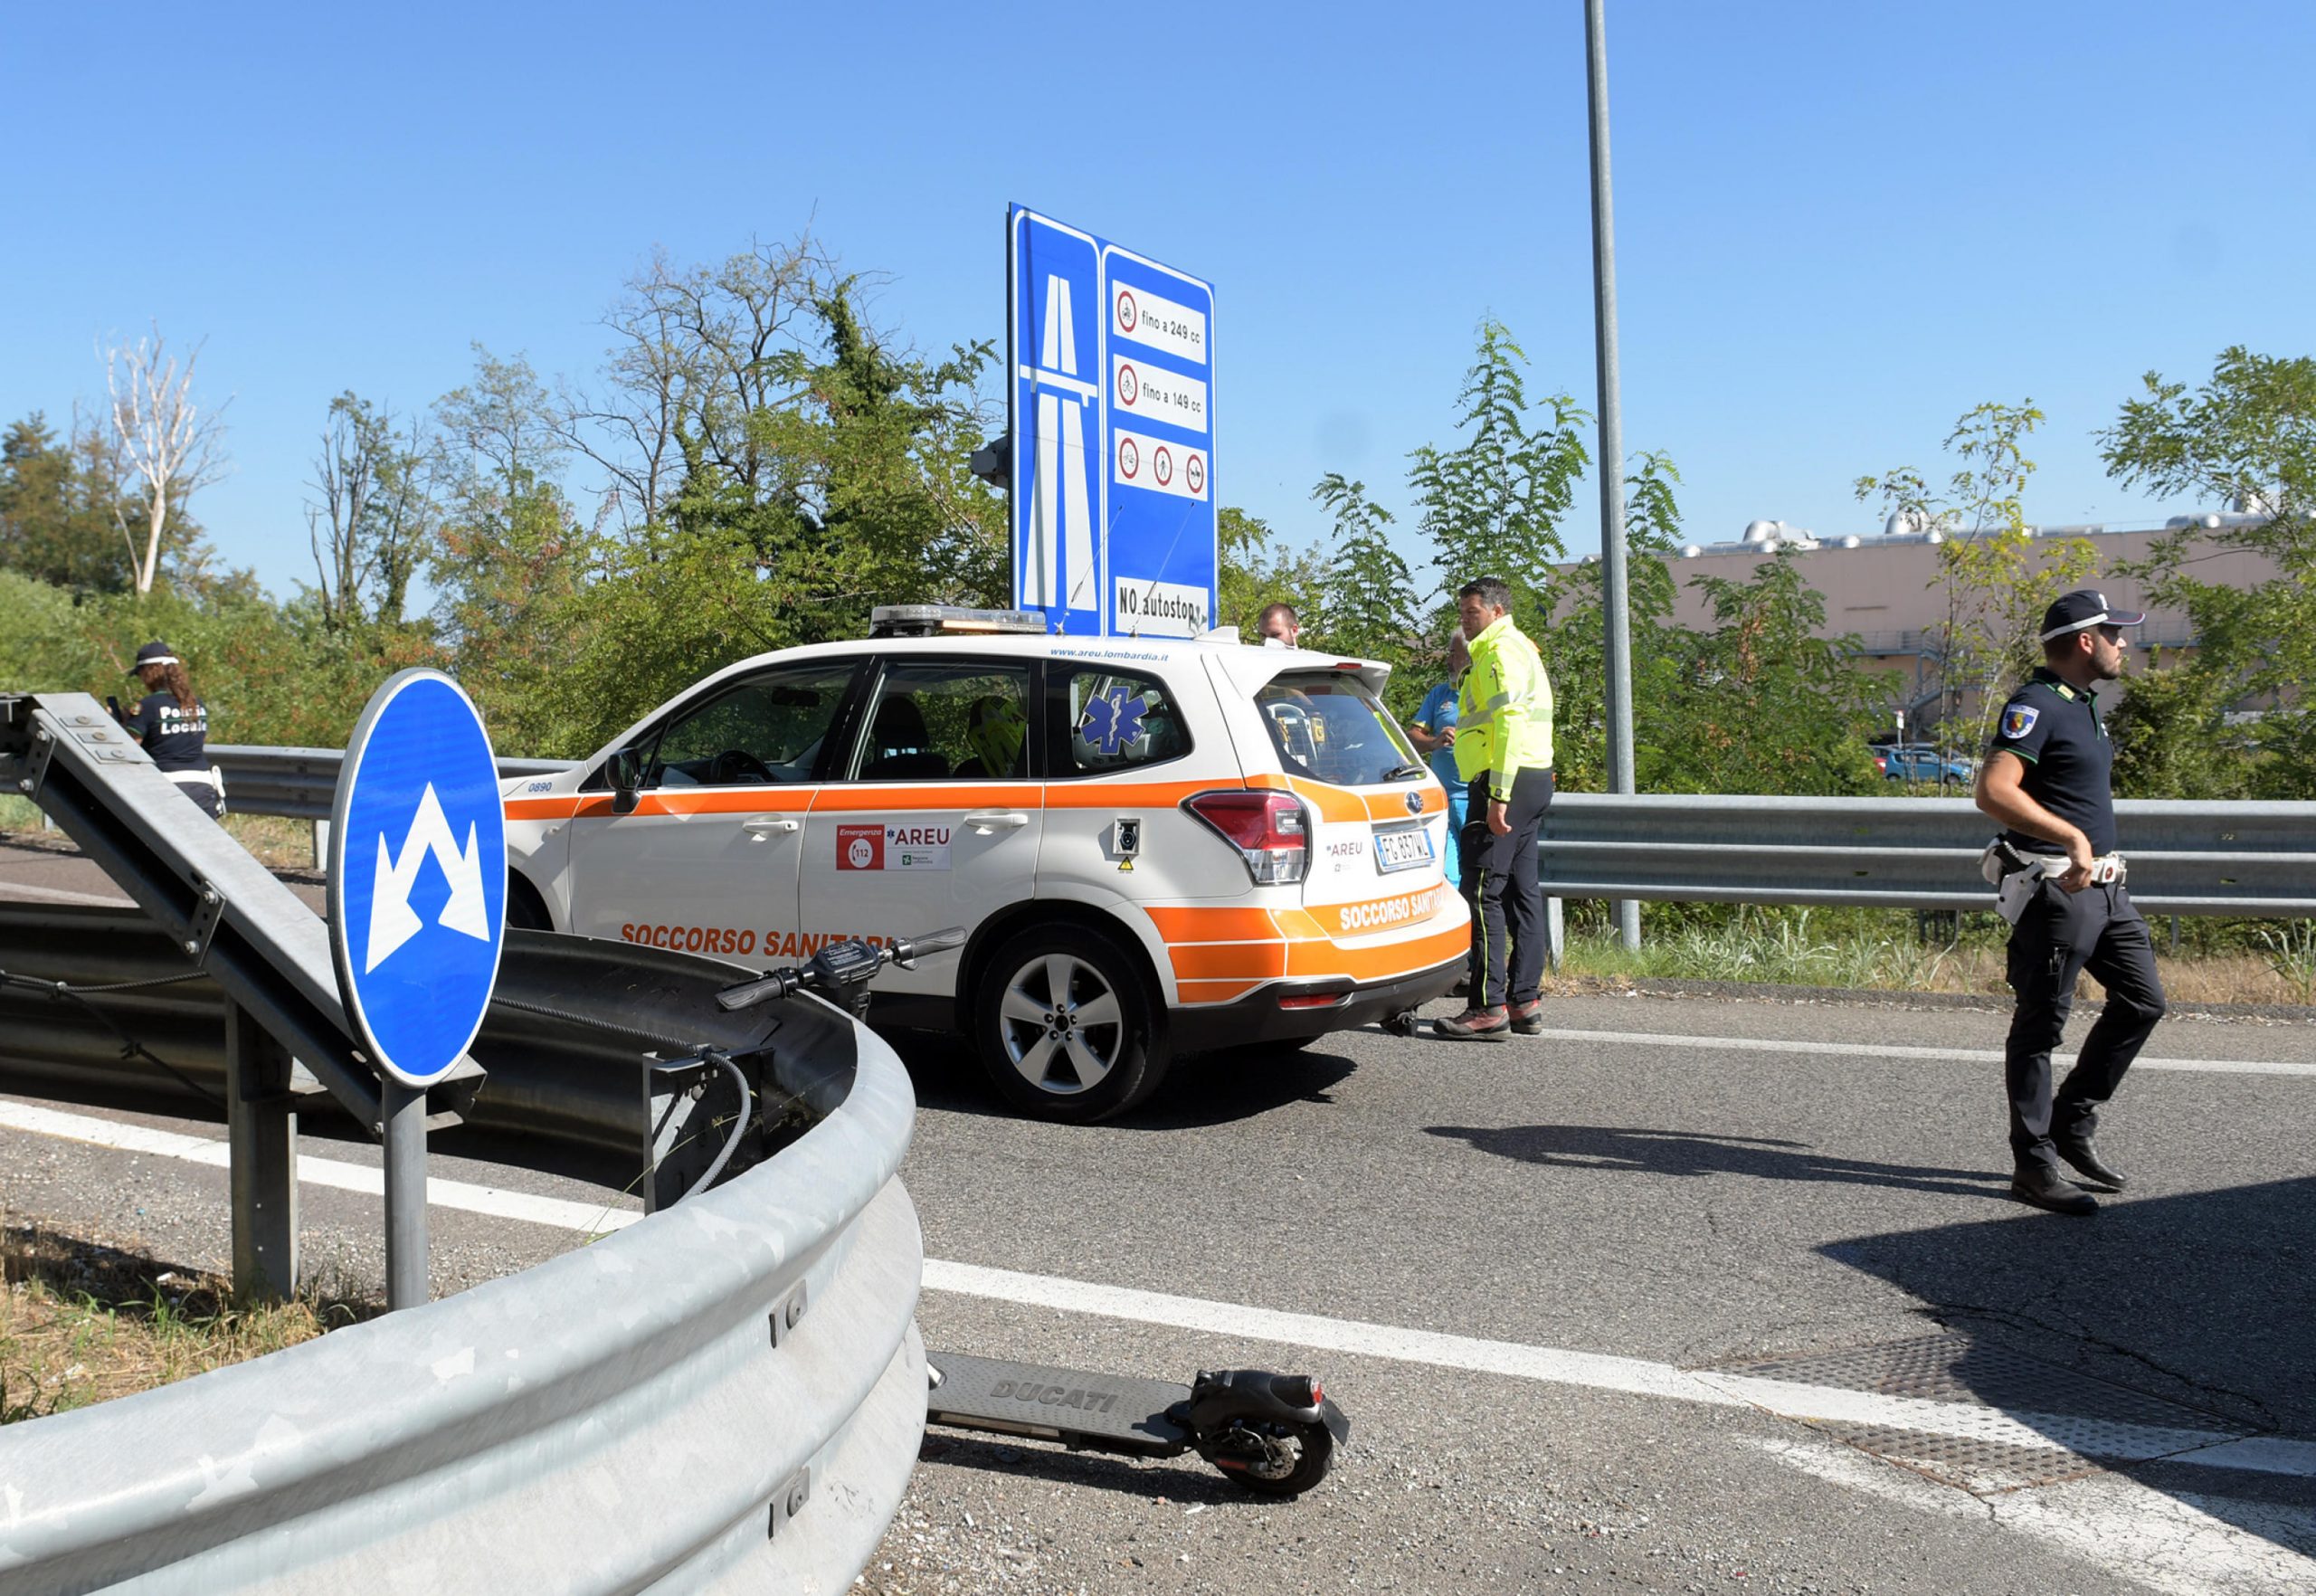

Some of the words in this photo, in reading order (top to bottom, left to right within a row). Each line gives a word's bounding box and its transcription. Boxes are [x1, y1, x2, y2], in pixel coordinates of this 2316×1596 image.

[1142, 309, 1160, 329] fino
[1163, 321, 1168, 333] a
[1170, 320, 1188, 339] 249
[1191, 331, 1201, 344] cc
[1143, 382, 1161, 402] fino
[1163, 392, 1169, 404] a
[1172, 392, 1189, 409] 149
[1191, 401, 1201, 413] cc
[1120, 586, 1137, 614] NO
[1144, 592, 1195, 629] autostop
[1050, 649, 1169, 661] www.areu.lombardia.it
[528, 782, 553, 793] 0890
[840, 828, 882, 838] Emergenza
[895, 828, 950, 845] AREU
[855, 849, 868, 858] 112
[1331, 841, 1362, 857] AREU
[1340, 897, 1410, 930] SOCCORSO
[620, 923, 756, 955] SOCCORSO
[990, 1380, 1118, 1413] DUCATI
